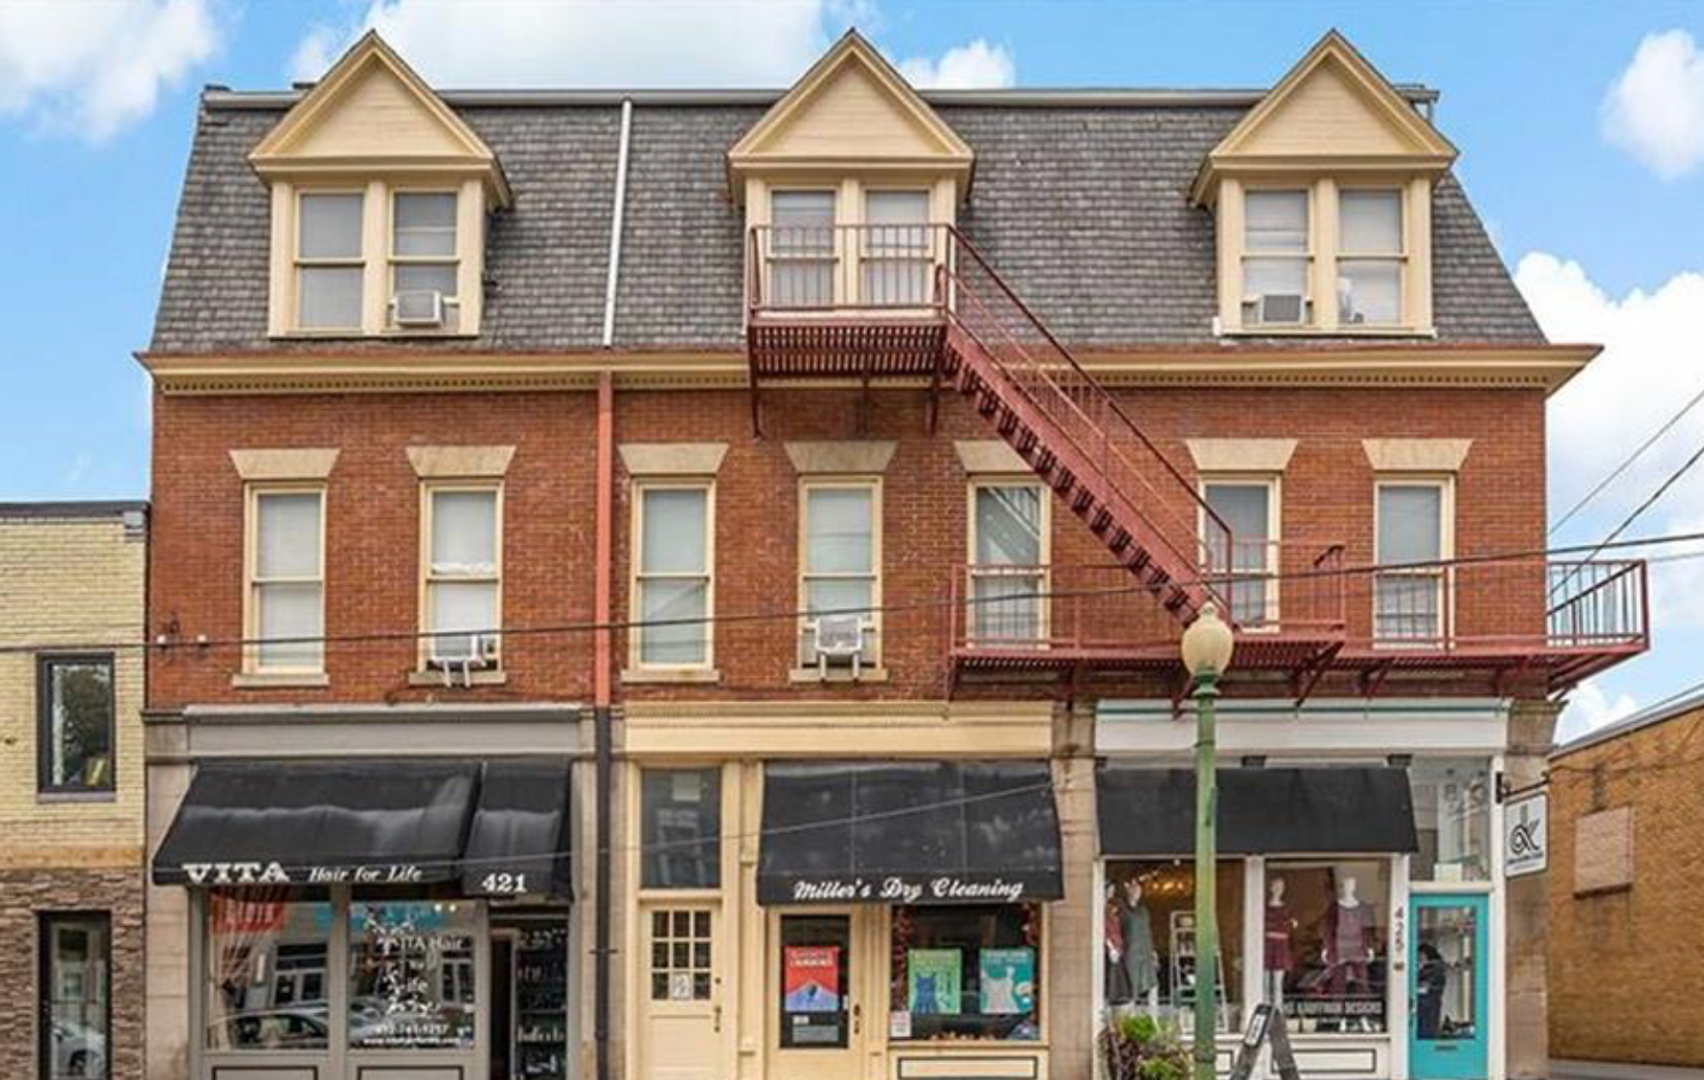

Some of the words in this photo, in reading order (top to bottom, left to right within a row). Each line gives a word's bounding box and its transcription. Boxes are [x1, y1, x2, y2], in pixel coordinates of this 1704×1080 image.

[182, 861, 290, 884] VITA
[309, 865, 348, 883] Hair
[354, 866, 380, 883] for
[387, 864, 423, 883] Life
[482, 873, 528, 893] 421
[794, 878, 871, 900] Miller's
[880, 876, 922, 903] Dry
[930, 876, 1024, 903] Cleaning
